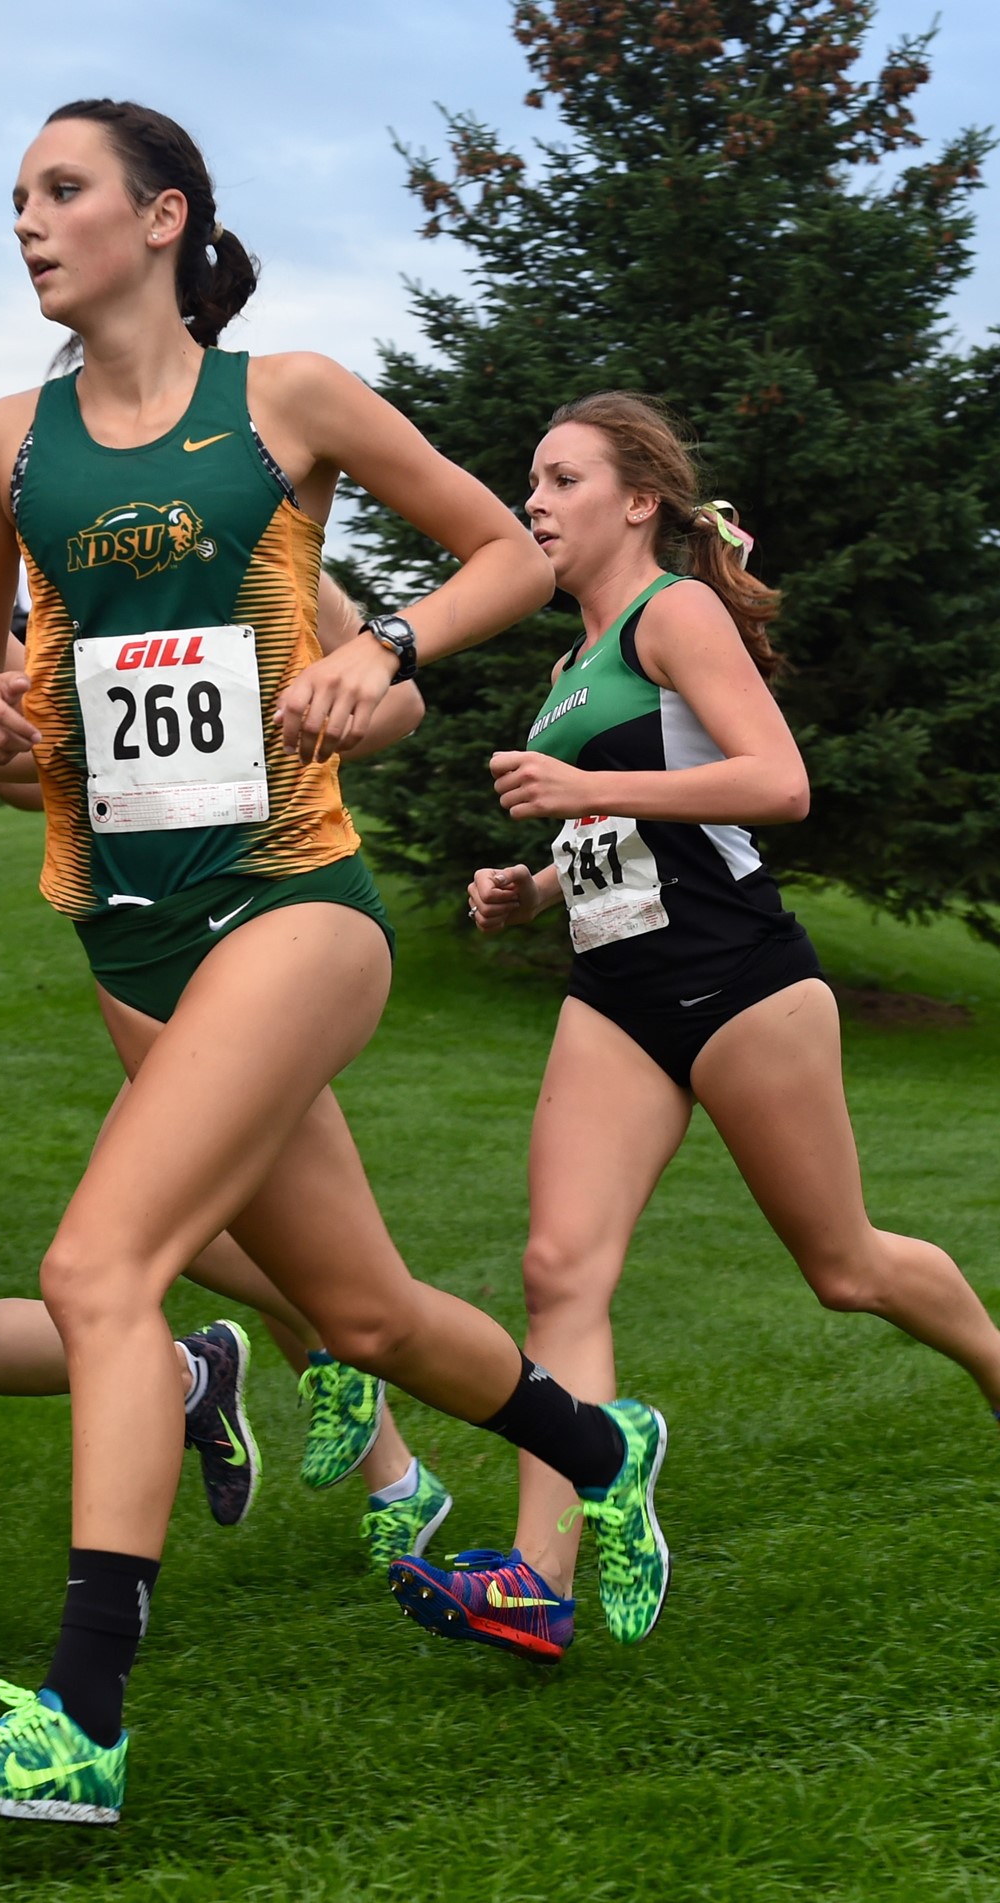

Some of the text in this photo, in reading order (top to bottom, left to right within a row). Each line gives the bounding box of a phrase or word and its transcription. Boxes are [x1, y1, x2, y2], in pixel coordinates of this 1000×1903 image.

[67, 524, 165, 572] NDSU
[115, 636, 205, 671] GILL
[107, 680, 224, 760] 268
[550, 686, 589, 724] DAKOTA
